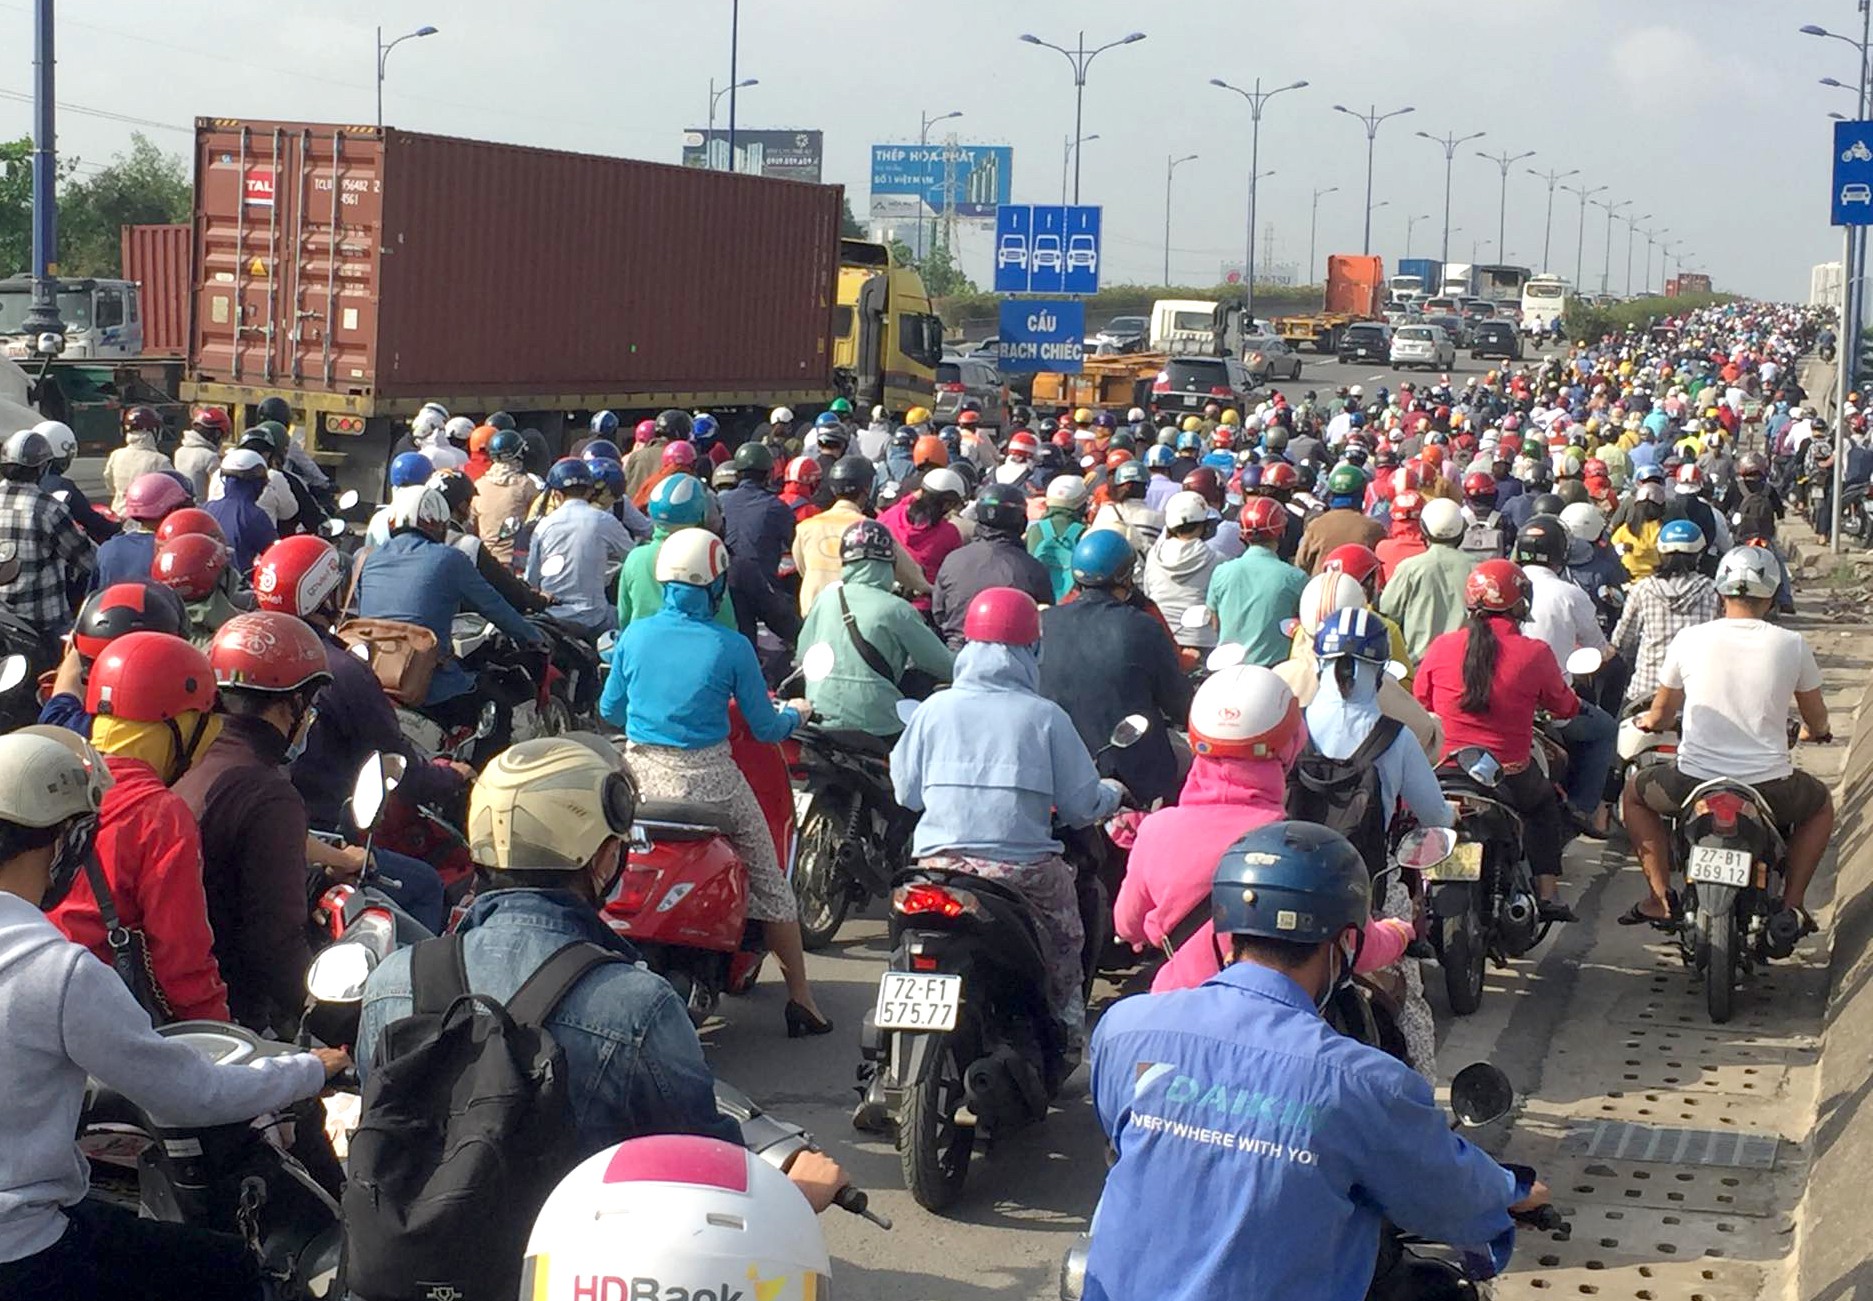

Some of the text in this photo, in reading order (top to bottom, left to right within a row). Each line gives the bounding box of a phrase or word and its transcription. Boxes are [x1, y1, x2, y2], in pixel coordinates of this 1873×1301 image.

[246, 180, 273, 192] TAL
[1040, 336, 1082, 360] CHIẾC
[1700, 849, 1741, 867] 27-B1
[1693, 863, 1745, 884] 369.12
[894, 978, 946, 1001] 72-F1
[884, 1001, 952, 1026] 575.77
[1238, 1136, 1282, 1158] WITH
[573, 1275, 744, 1301] HDBank
